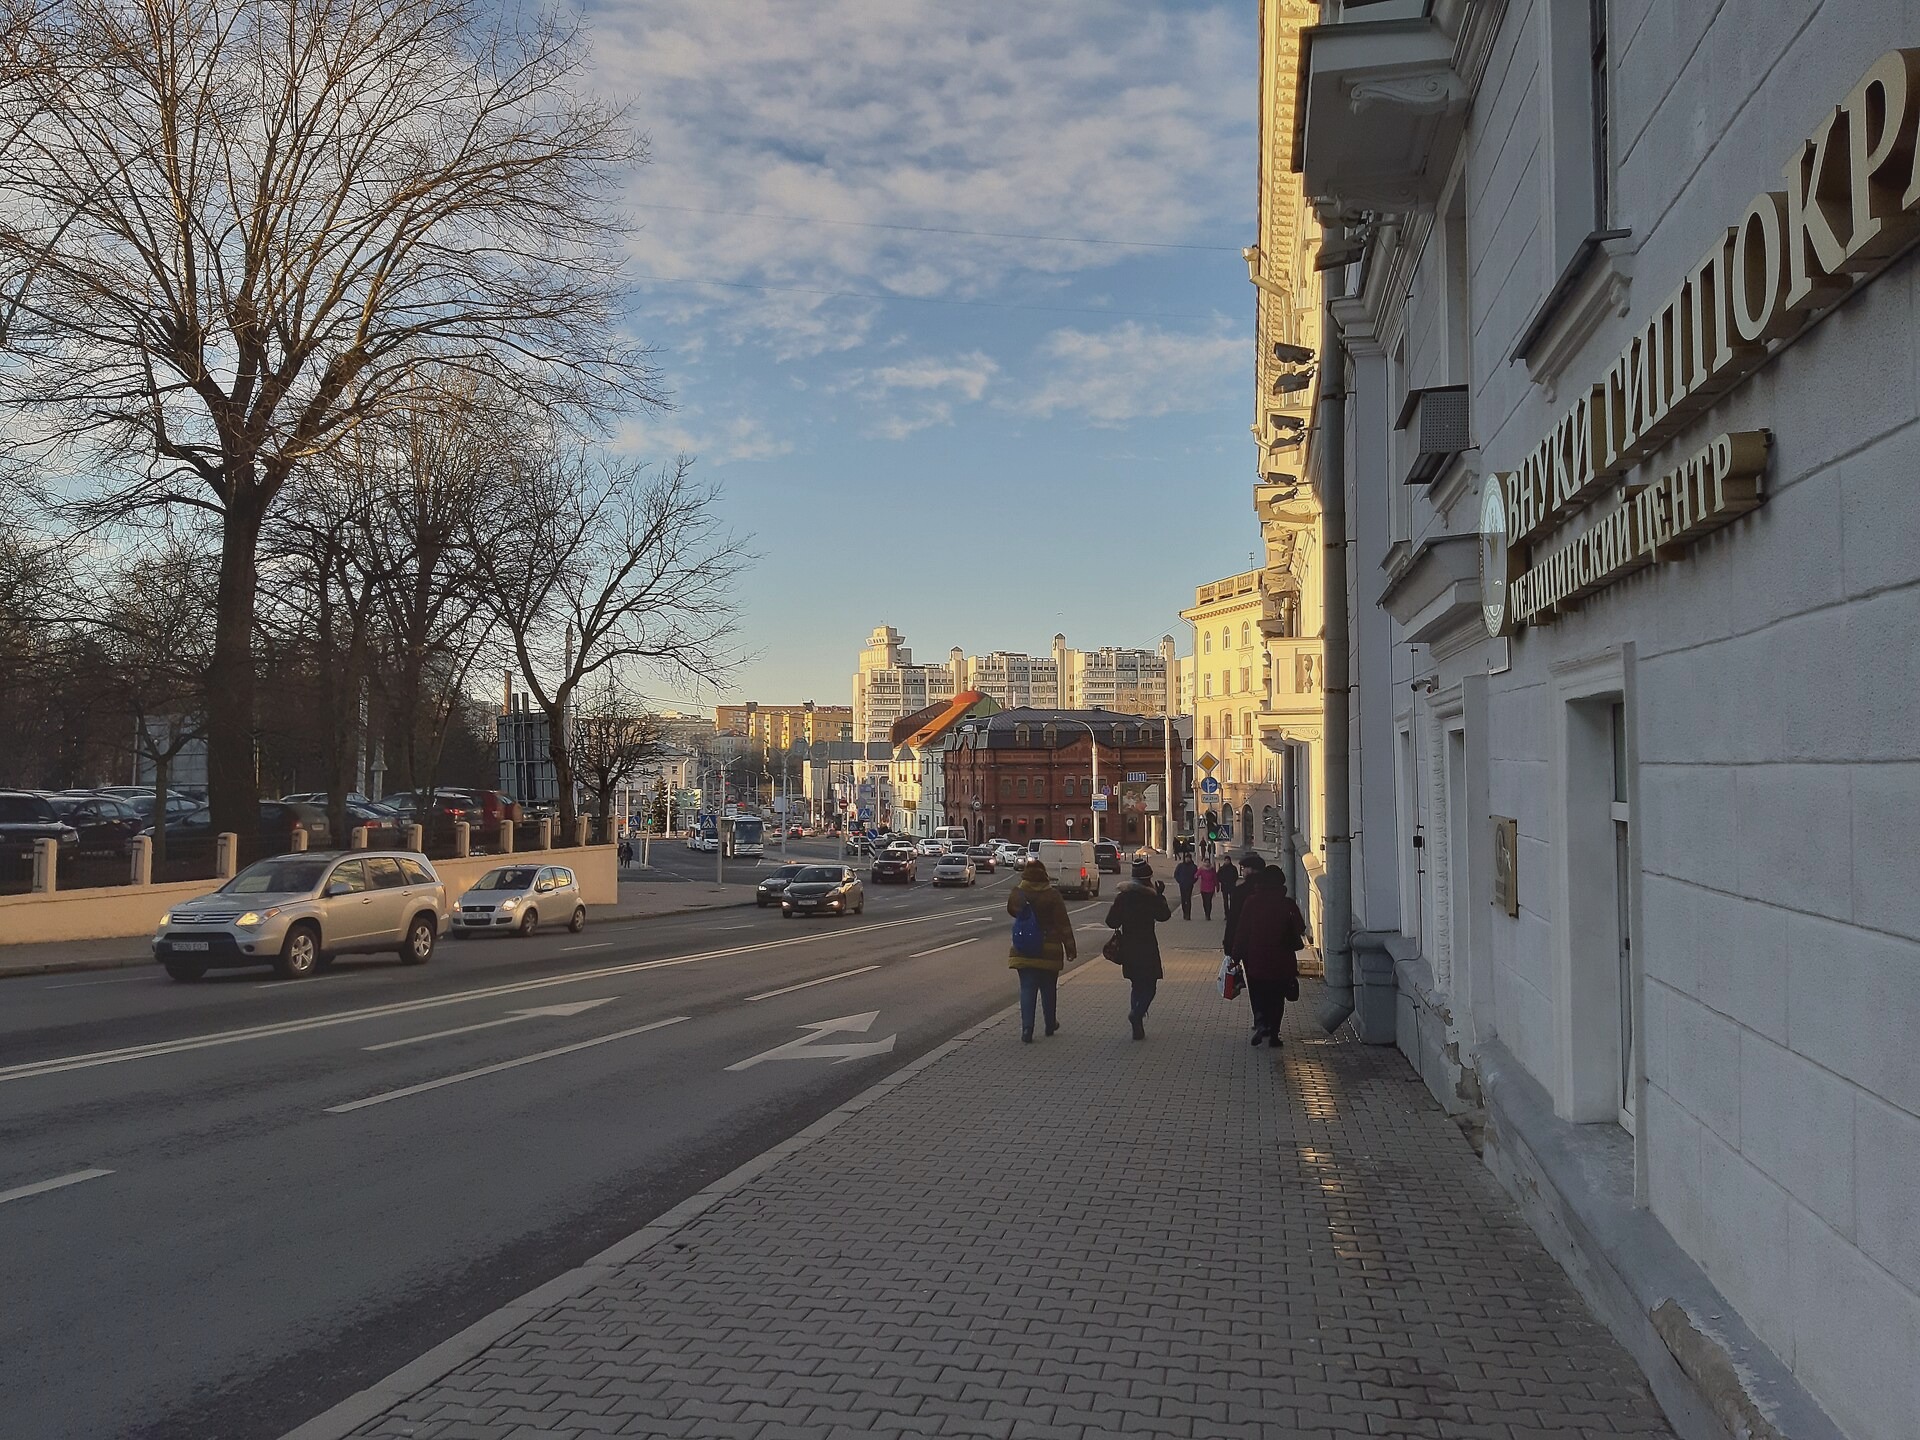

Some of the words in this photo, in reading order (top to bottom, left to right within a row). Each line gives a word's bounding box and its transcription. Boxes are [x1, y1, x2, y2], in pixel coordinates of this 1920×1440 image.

[1507, 385, 1595, 548] ВНУКИ
[1603, 48, 1920, 467] ГИППОКР
[1510, 486, 1633, 626] МЕДИЦИНСКИЙ
[1637, 432, 1732, 564] ЦЕНТР
